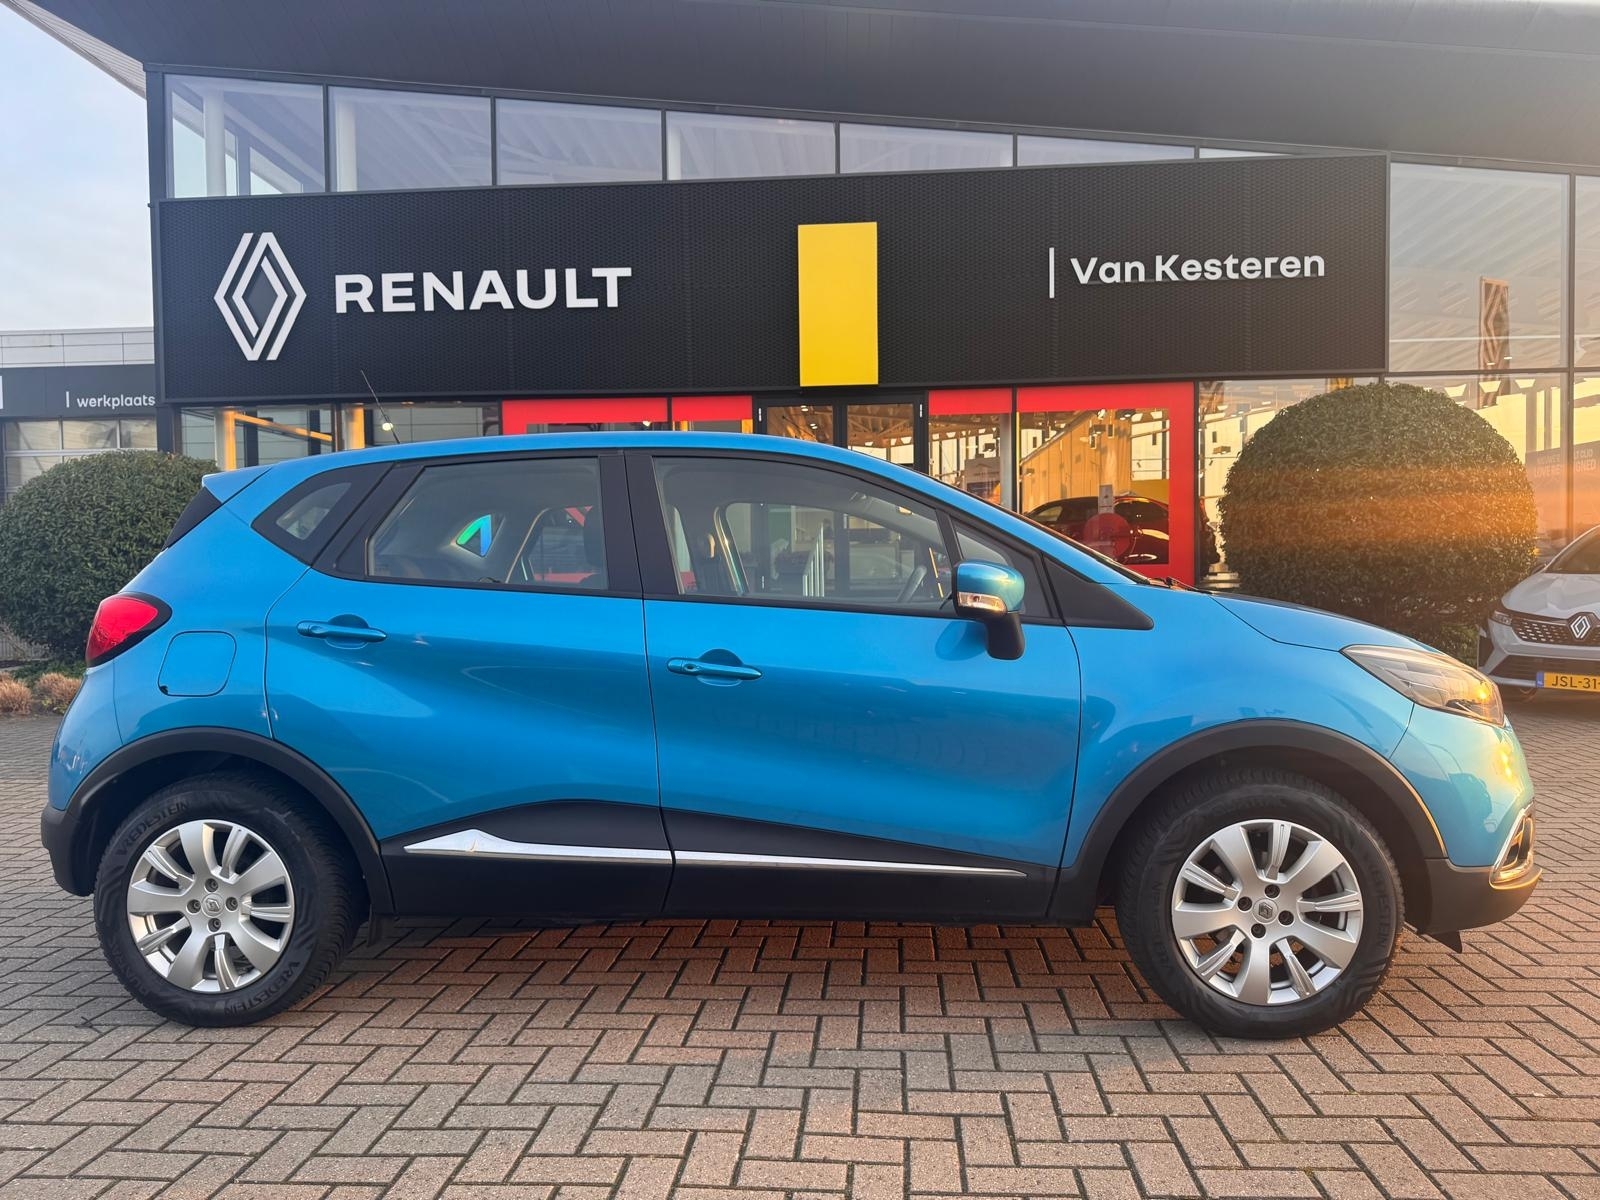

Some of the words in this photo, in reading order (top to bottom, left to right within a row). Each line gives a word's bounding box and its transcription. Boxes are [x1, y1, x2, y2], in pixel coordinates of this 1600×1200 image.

[1070, 257, 1145, 284] Van
[1155, 254, 1325, 281] Kesteren
[335, 267, 632, 313] RENAULT
[77, 394, 156, 410] werkplaats
